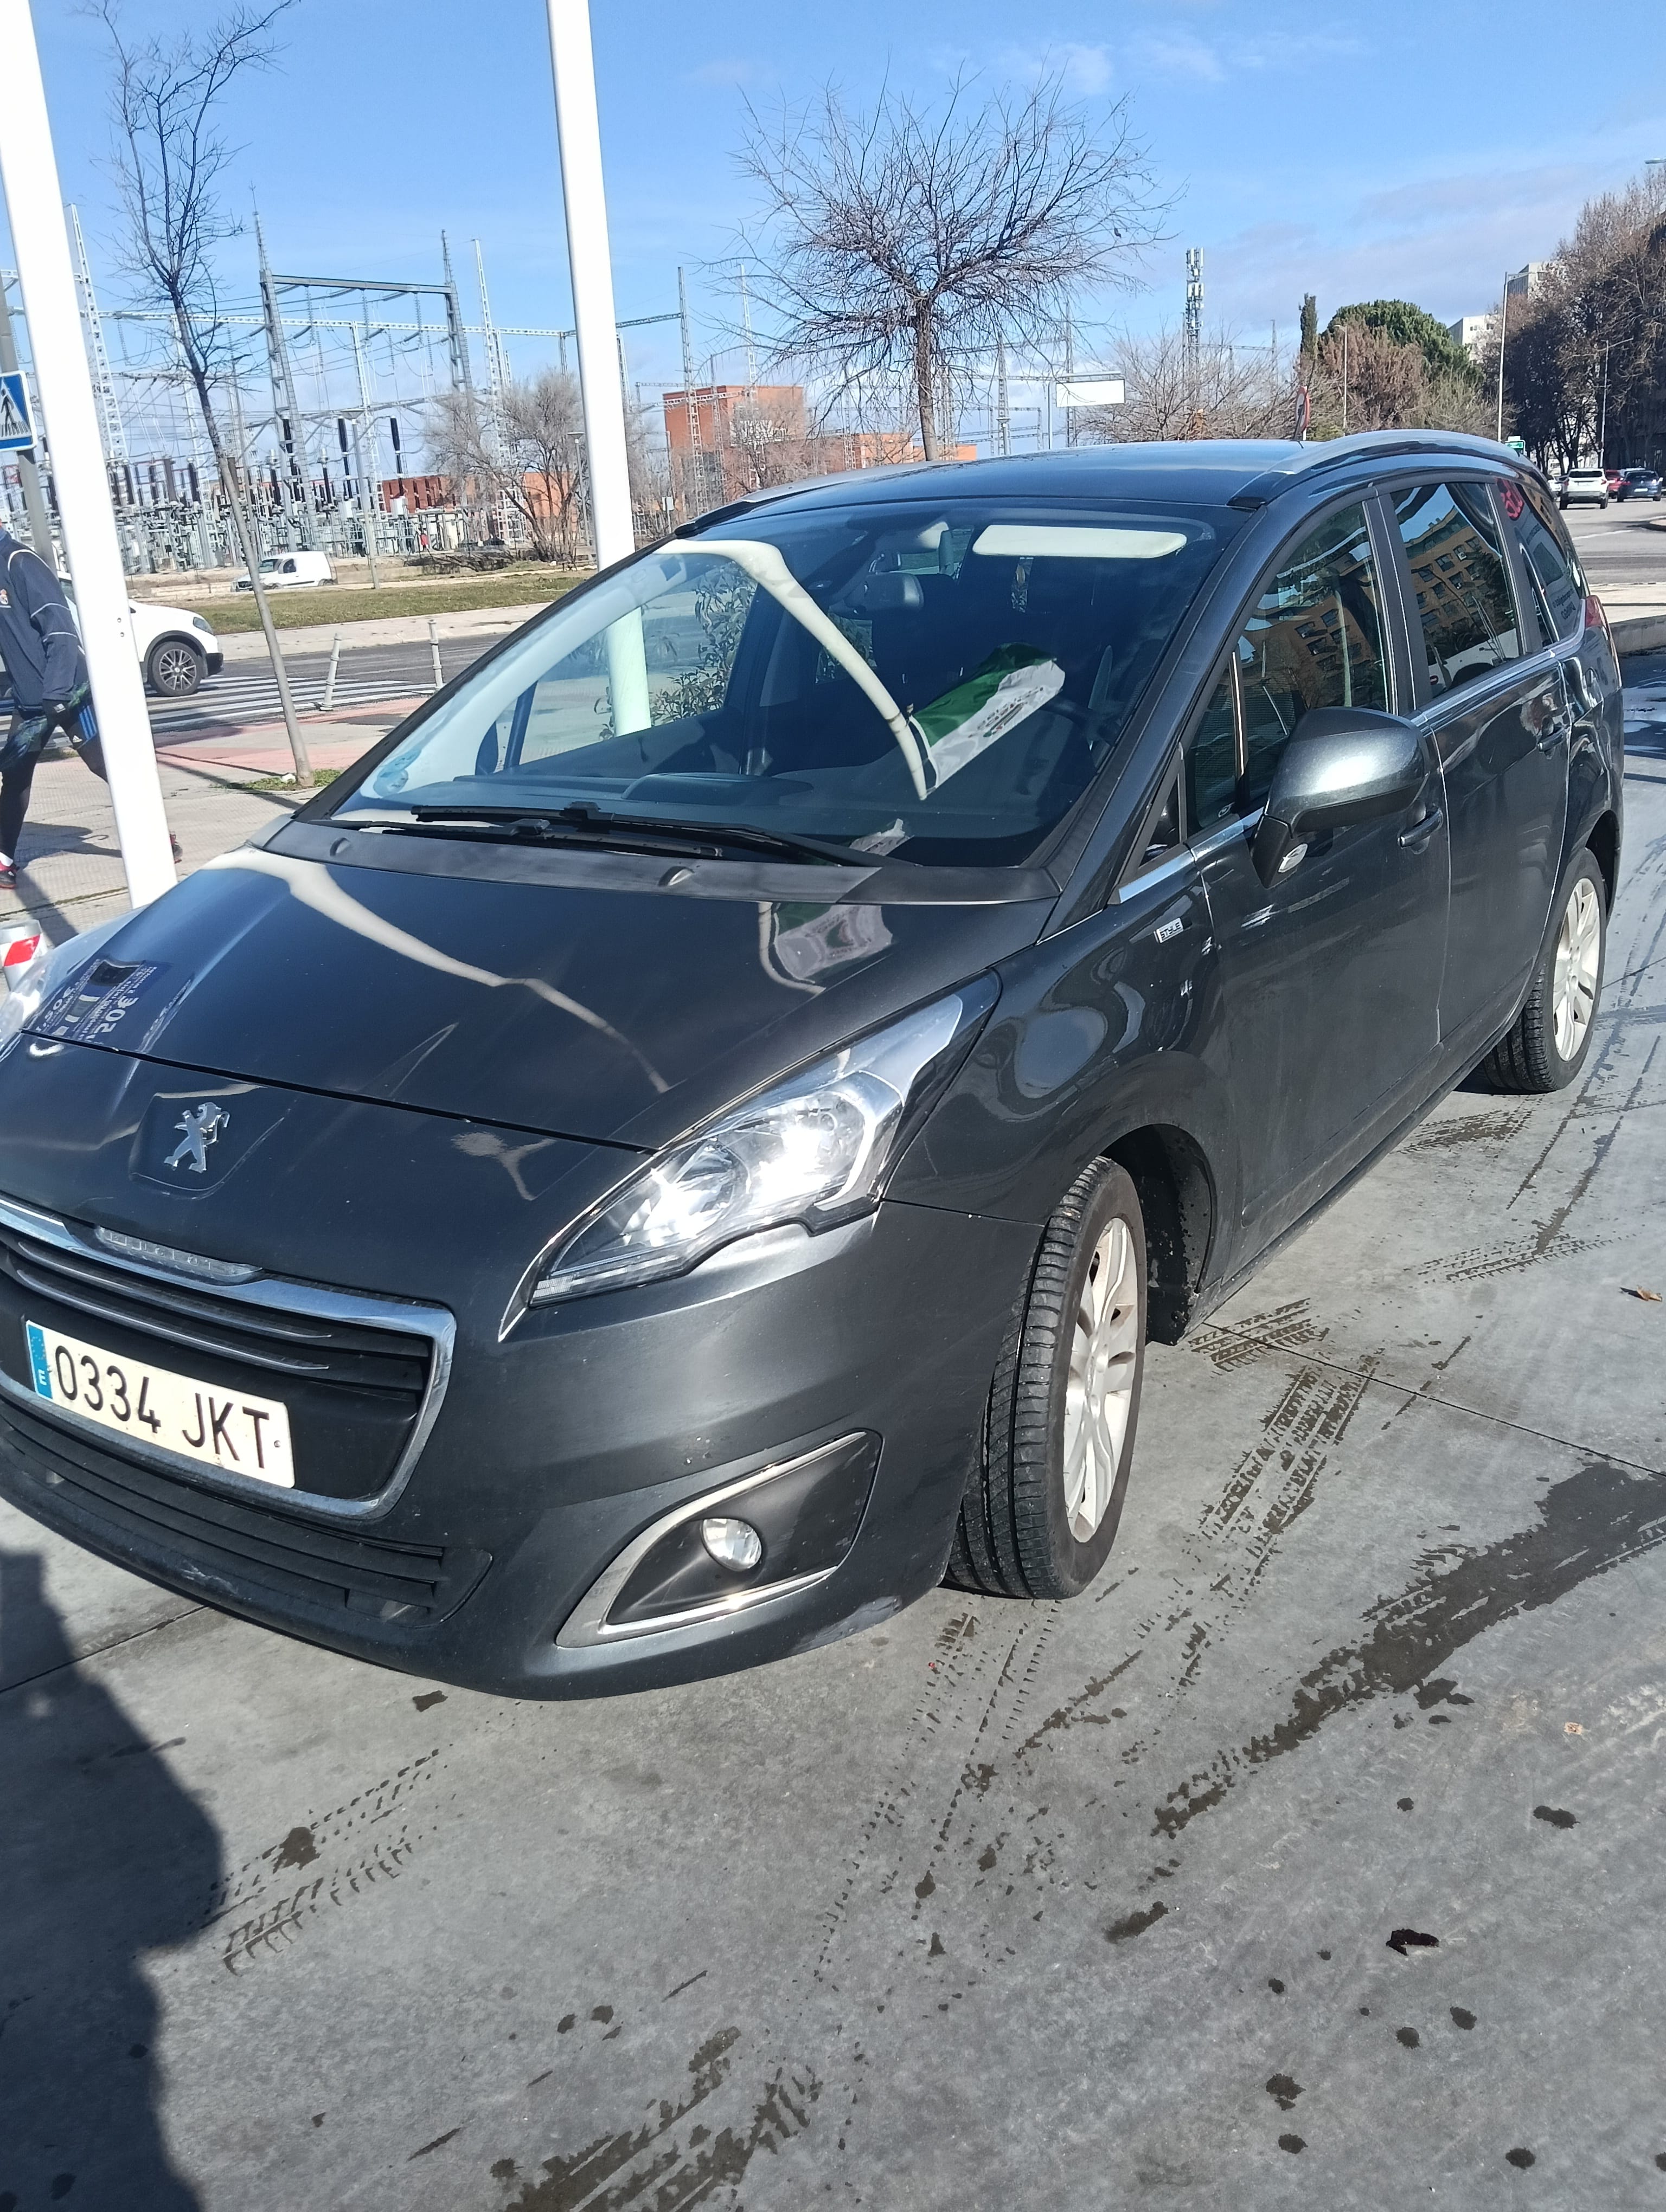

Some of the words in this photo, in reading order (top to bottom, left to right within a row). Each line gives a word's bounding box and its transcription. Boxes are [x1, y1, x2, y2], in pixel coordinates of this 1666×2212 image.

[1159, 922, 1181, 938] STYLE
[38, 1368, 47, 1386] E
[55, 1345, 161, 1434] 0334
[182, 1392, 270, 1469] JKT
